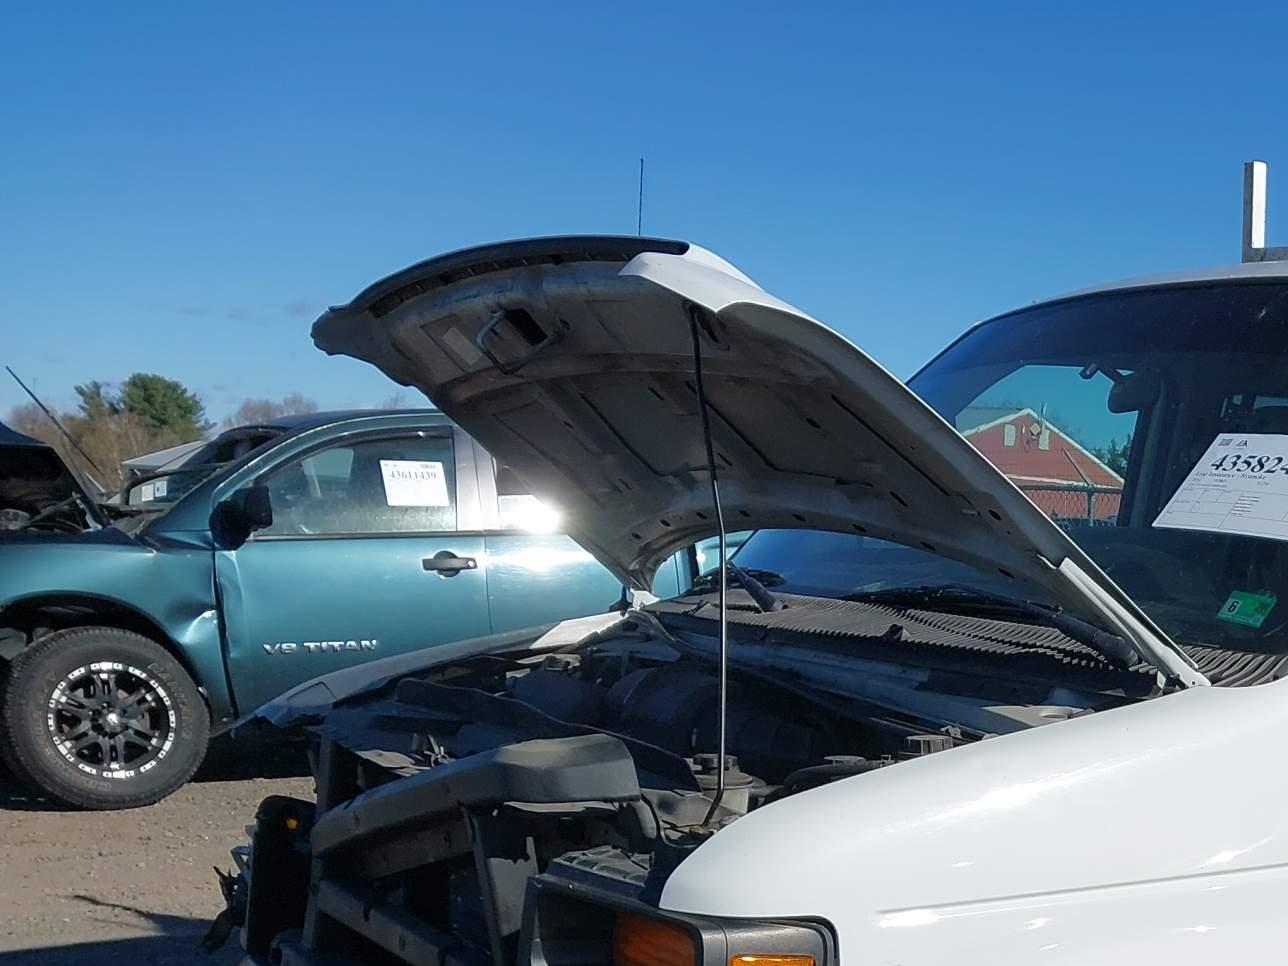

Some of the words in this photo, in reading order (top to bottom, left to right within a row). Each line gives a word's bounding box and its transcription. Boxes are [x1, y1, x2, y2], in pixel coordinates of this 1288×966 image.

[1227, 600, 1239, 613] 6
[263, 643, 297, 654] V8
[303, 639, 377, 653] TITAN
